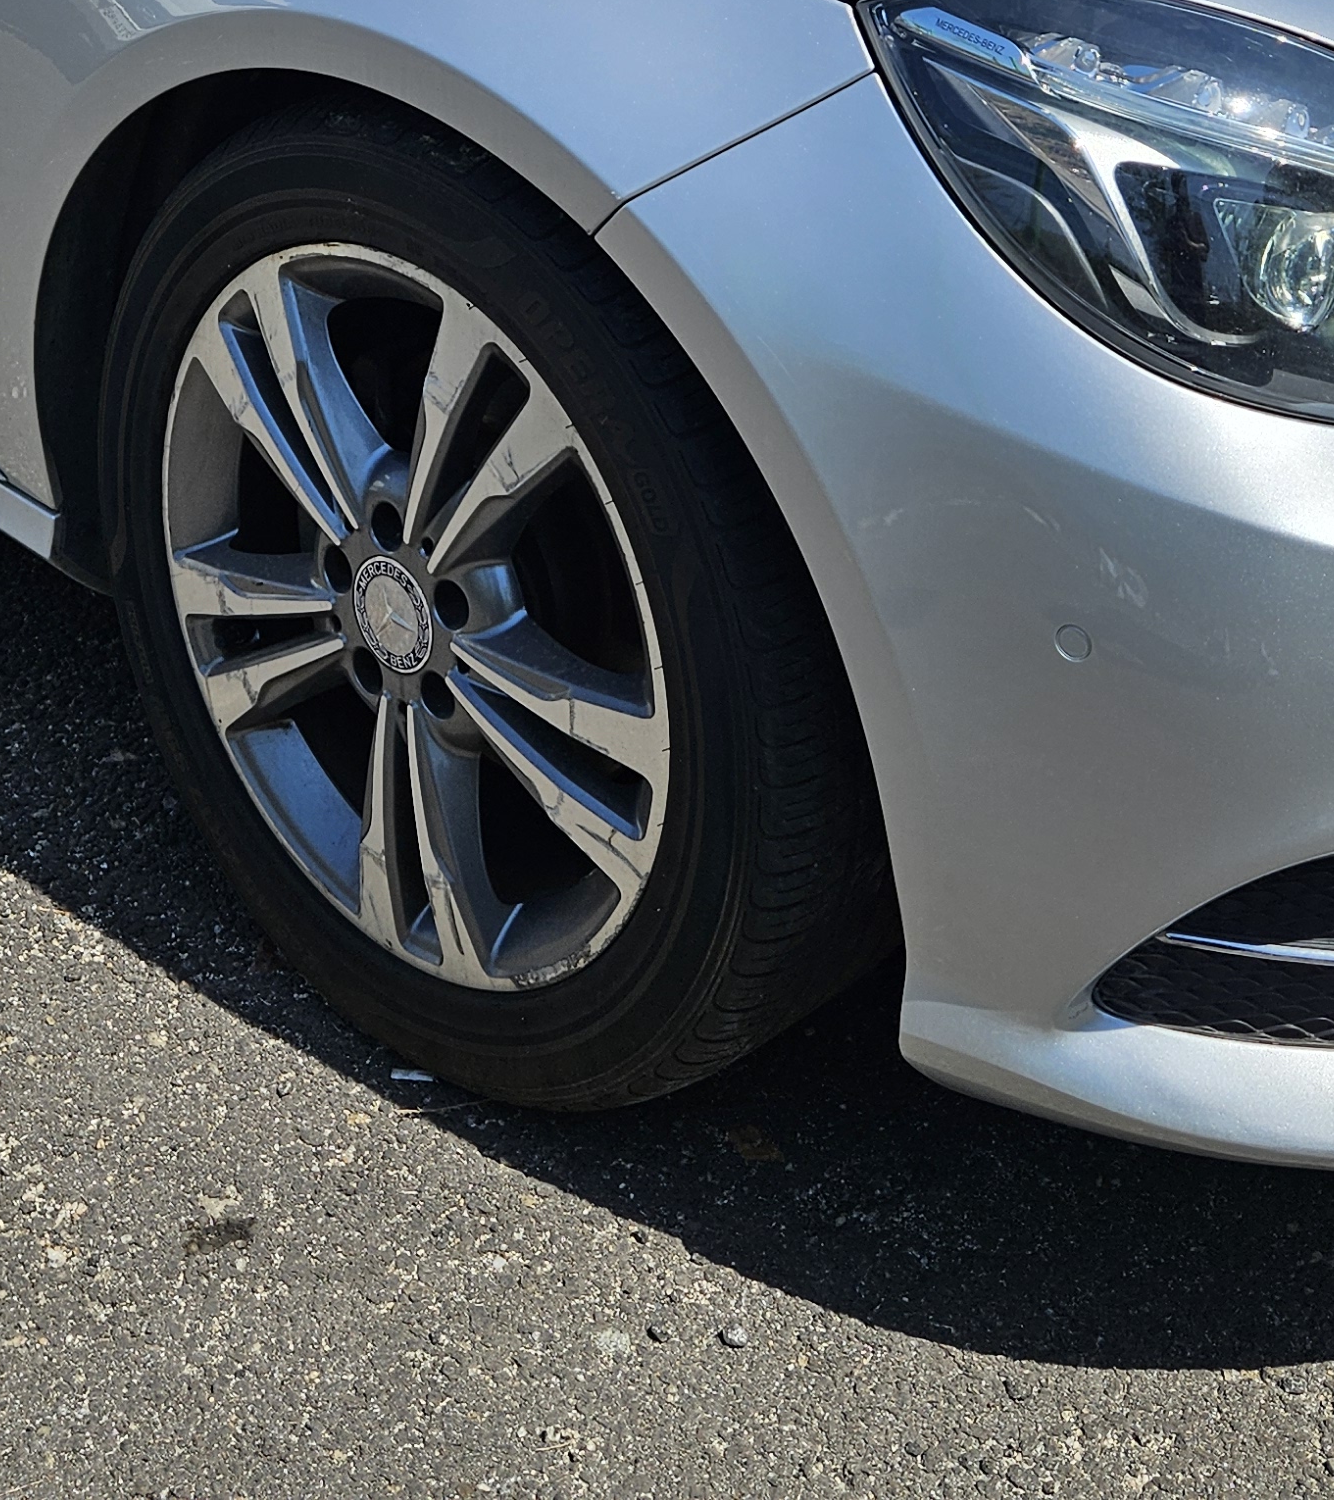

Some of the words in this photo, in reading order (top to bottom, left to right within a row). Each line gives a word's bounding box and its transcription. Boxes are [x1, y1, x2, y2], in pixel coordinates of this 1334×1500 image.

[935, 18, 1006, 56] MERCEDES-BENZ
[358, 562, 408, 591] MERCEDES
[389, 652, 419, 669] BENZ
